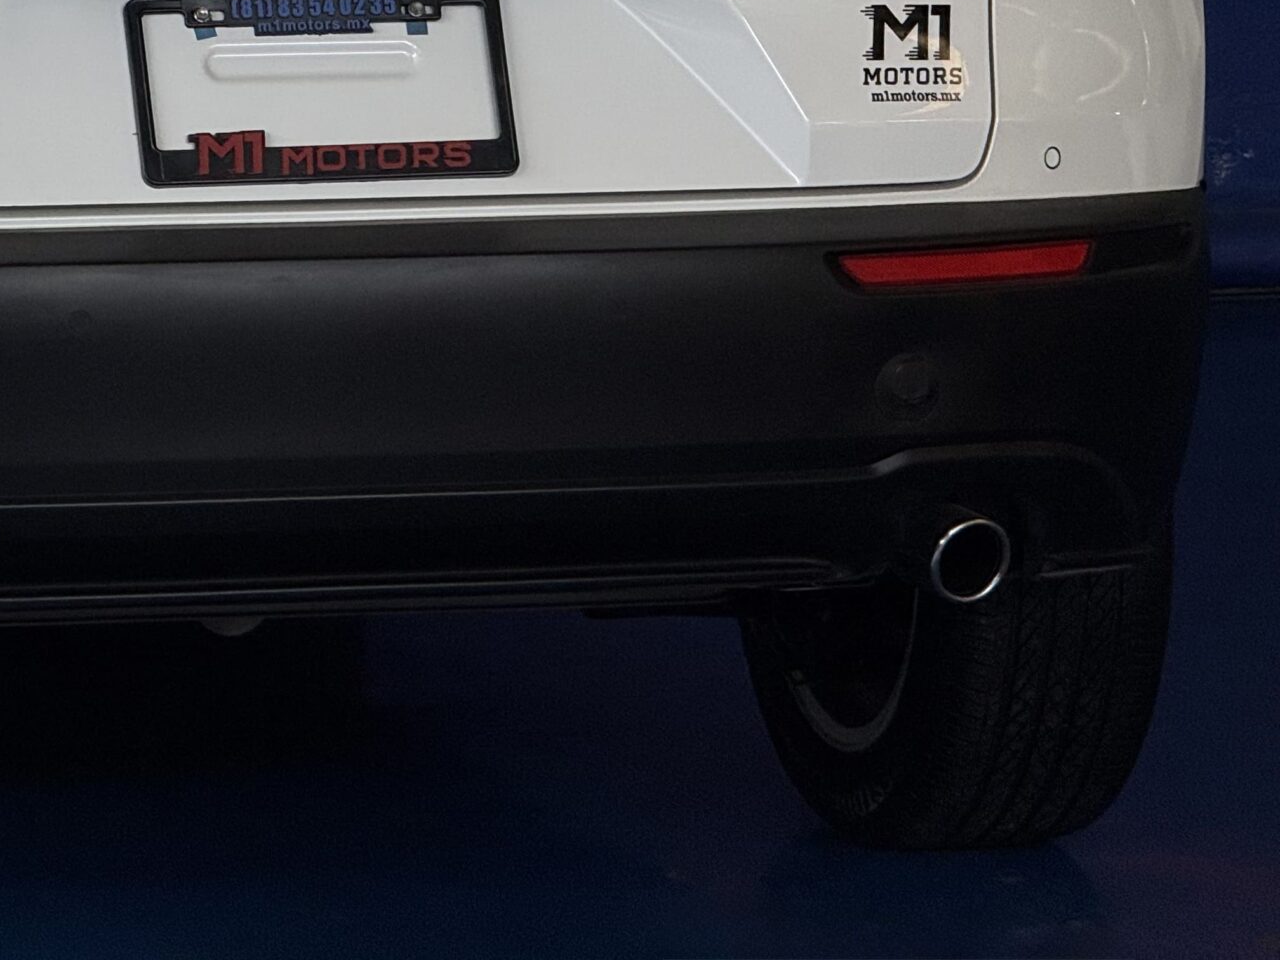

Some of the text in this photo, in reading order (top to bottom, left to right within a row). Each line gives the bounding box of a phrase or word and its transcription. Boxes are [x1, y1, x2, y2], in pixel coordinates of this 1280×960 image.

[257, 18, 371, 33] m1motors.mx
[861, 4, 951, 61] M1
[862, 67, 963, 85] MOTORS
[871, 90, 961, 103] m1motors.mx
[195, 131, 472, 176] M1 MOTORS
